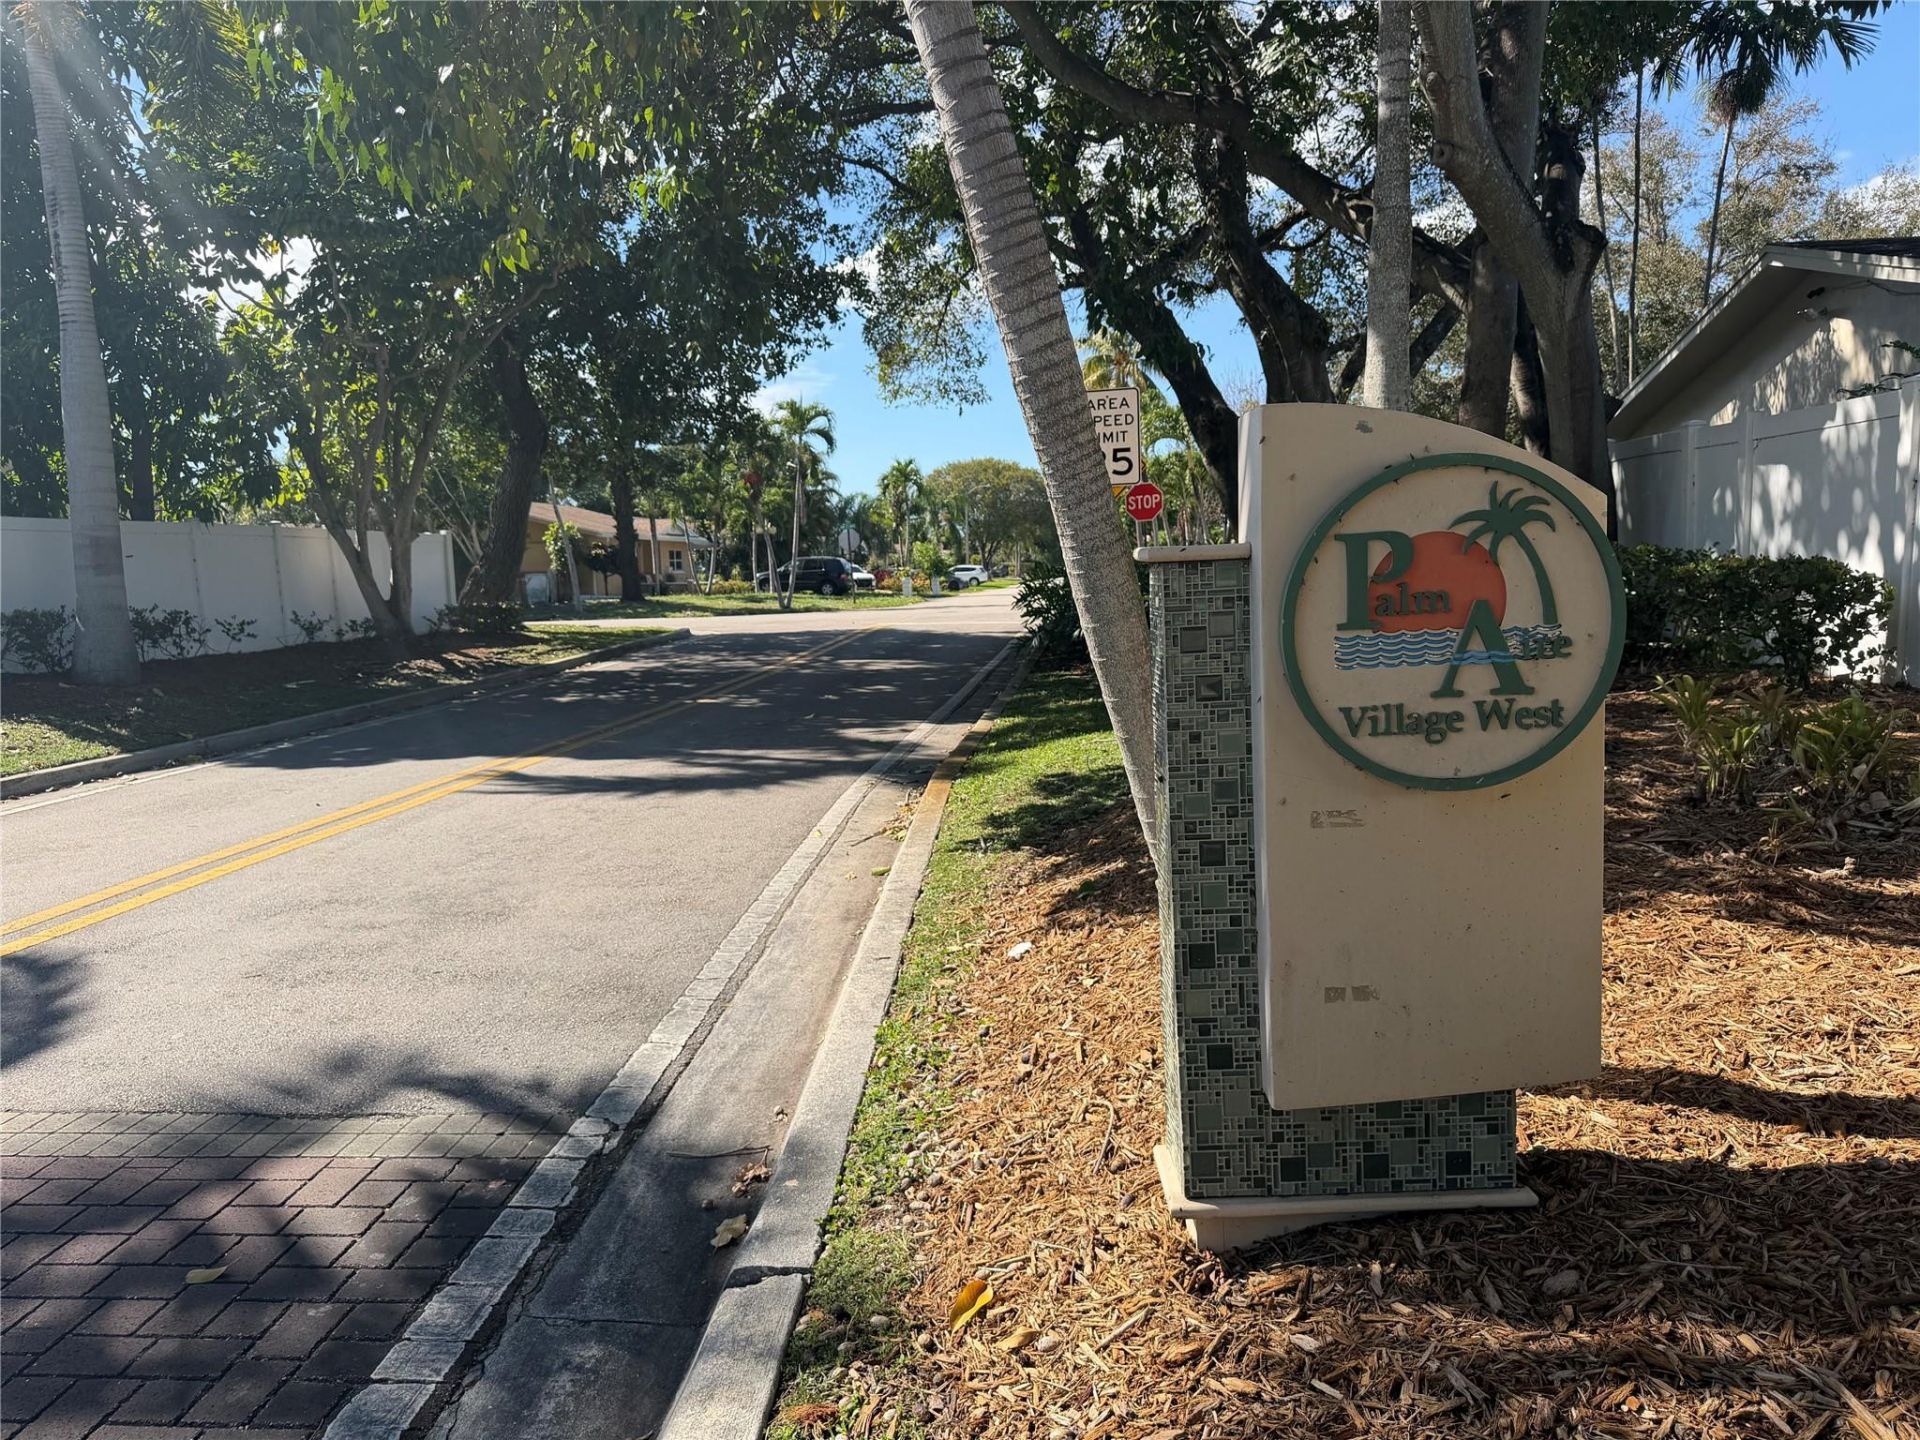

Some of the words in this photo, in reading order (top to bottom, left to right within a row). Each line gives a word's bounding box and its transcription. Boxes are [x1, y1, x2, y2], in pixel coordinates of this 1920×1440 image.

[1088, 397, 1130, 411] AREA
[1093, 413, 1134, 427] PEED
[1098, 430, 1128, 443] IMIT
[1102, 447, 1134, 476] 5
[1128, 494, 1160, 511] STOP
[1333, 530, 1453, 632] Palm
[1429, 599, 1573, 698] Aire
[1338, 702, 1465, 744] Village
[1472, 697, 1565, 732] West
